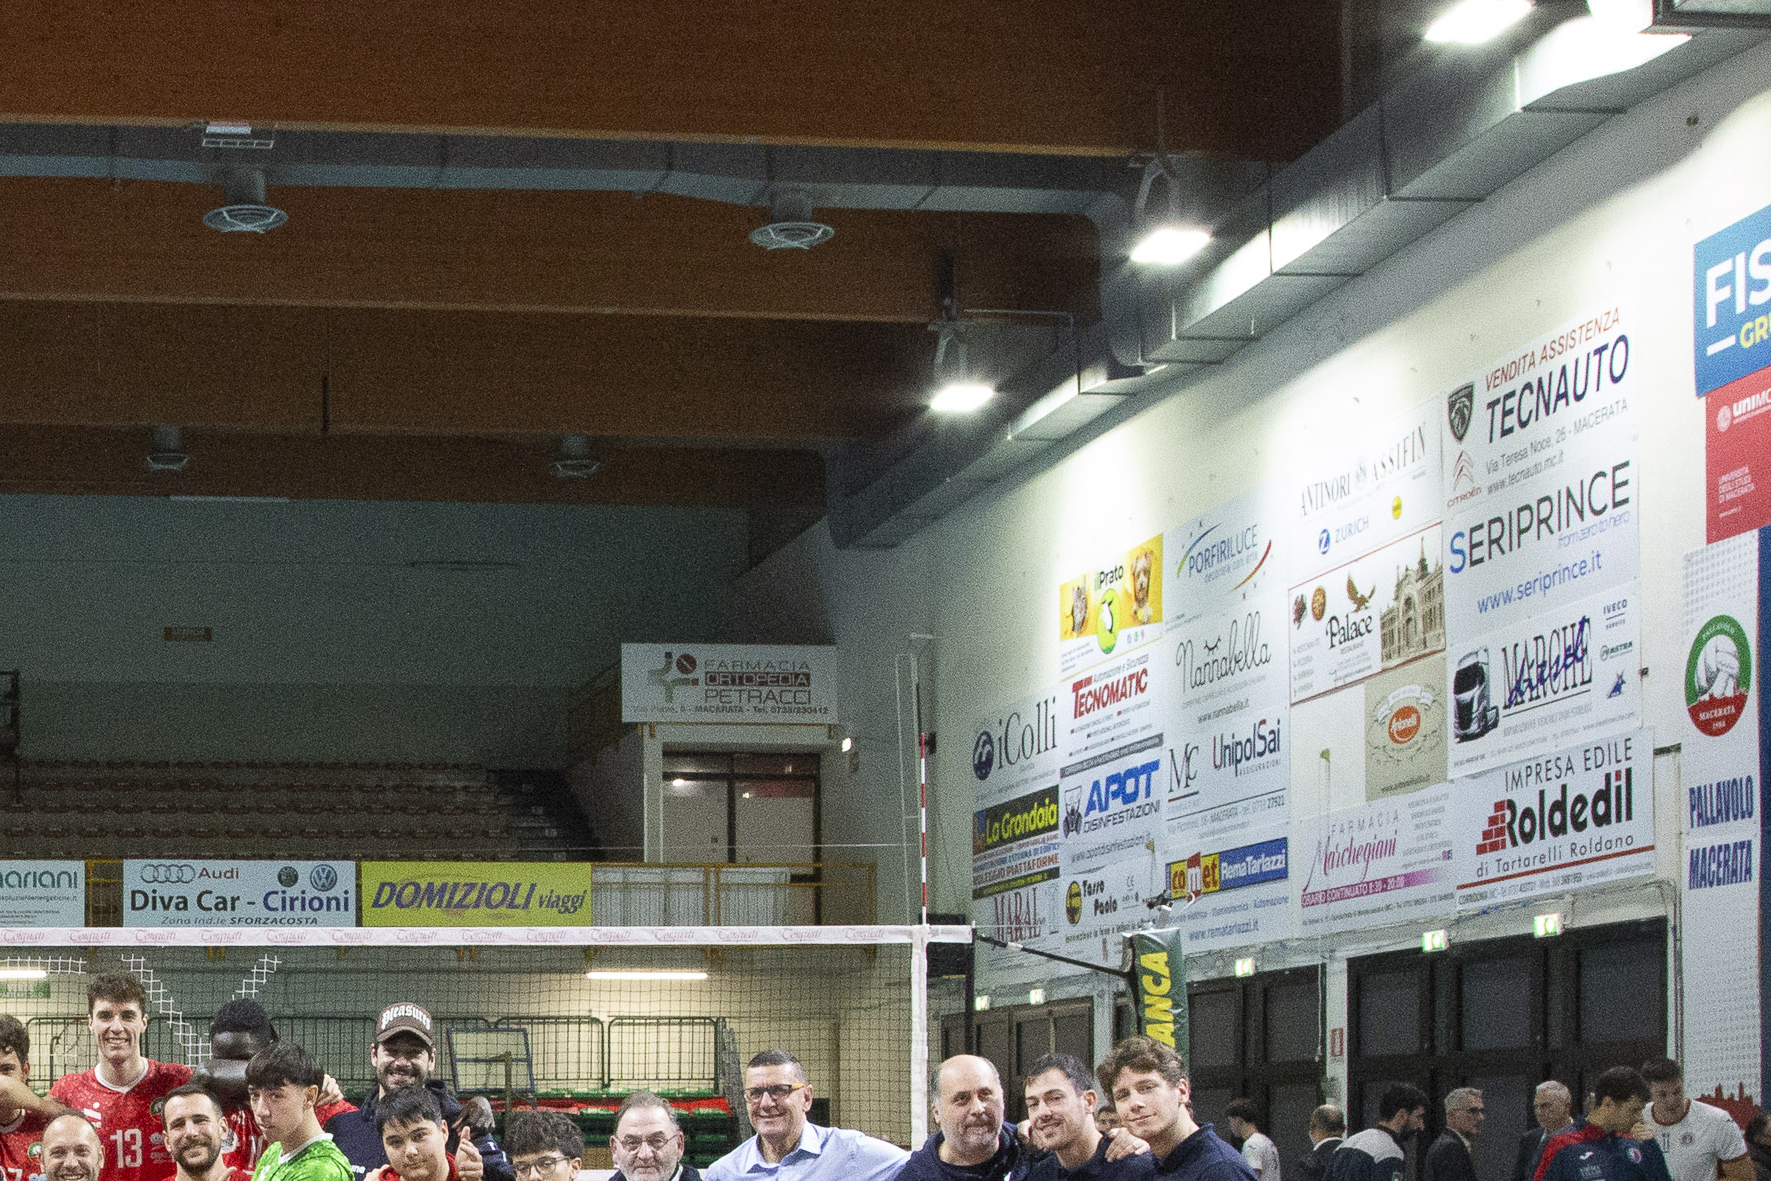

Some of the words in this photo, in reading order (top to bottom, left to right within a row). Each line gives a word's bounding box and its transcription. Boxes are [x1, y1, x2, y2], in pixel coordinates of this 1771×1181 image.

[1485, 350, 1536, 392] VENDITA
[1539, 306, 1620, 365] ASSISTENZA
[1486, 334, 1629, 443] TECNAUTO
[1498, 446, 1529, 469] Teresa
[1573, 399, 1628, 435] MACERATA
[1334, 515, 1370, 544] ZURICH
[1450, 460, 1630, 574] SERIPRINCE
[1188, 524, 1258, 578] PORFIRILUCE
[1477, 551, 1603, 614] www.seriprince.it
[1603, 598, 1628, 615] IVECO
[1325, 613, 1373, 650] Palace
[704, 658, 810, 671] FARMACIA
[706, 673, 809, 686] ORTOPEDIA
[704, 688, 811, 705] PETRACCI
[1072, 668, 1148, 719] TECNOMATIC
[1698, 704, 1736, 722] MACERATA
[1212, 718, 1281, 777] UnipolSai
[1505, 755, 1575, 793] IMPRESA
[1584, 737, 1632, 772] EDILE
[1084, 758, 1160, 818] APOT
[1505, 767, 1633, 848] Roldedil
[1689, 775, 1754, 829] PALLAVOLO
[985, 818, 1000, 845] La
[1001, 797, 1058, 841] Grondaia
[1083, 800, 1161, 834] DISINFESTAZIONI
[1331, 809, 1400, 836] FARMACIA
[198, 867, 240, 880] Audi
[1302, 829, 1398, 893] Marchegiani
[1476, 861, 1489, 878] di
[1496, 845, 1562, 874] Tartarelli
[1571, 834, 1634, 859] Roldano
[1688, 840, 1753, 890] MACERATA
[130, 888, 189, 912] Diva
[196, 889, 241, 912] Car
[263, 889, 350, 912] Cirioni
[161, 917, 191, 925] Zona
[229, 917, 318, 925] SFORZACOSTA
[372, 881, 537, 910] DOMIZIOLI
[538, 889, 588, 915] viaggi
[1140, 951, 1176, 1048] ANCA
[110, 1128, 143, 1169] 13
